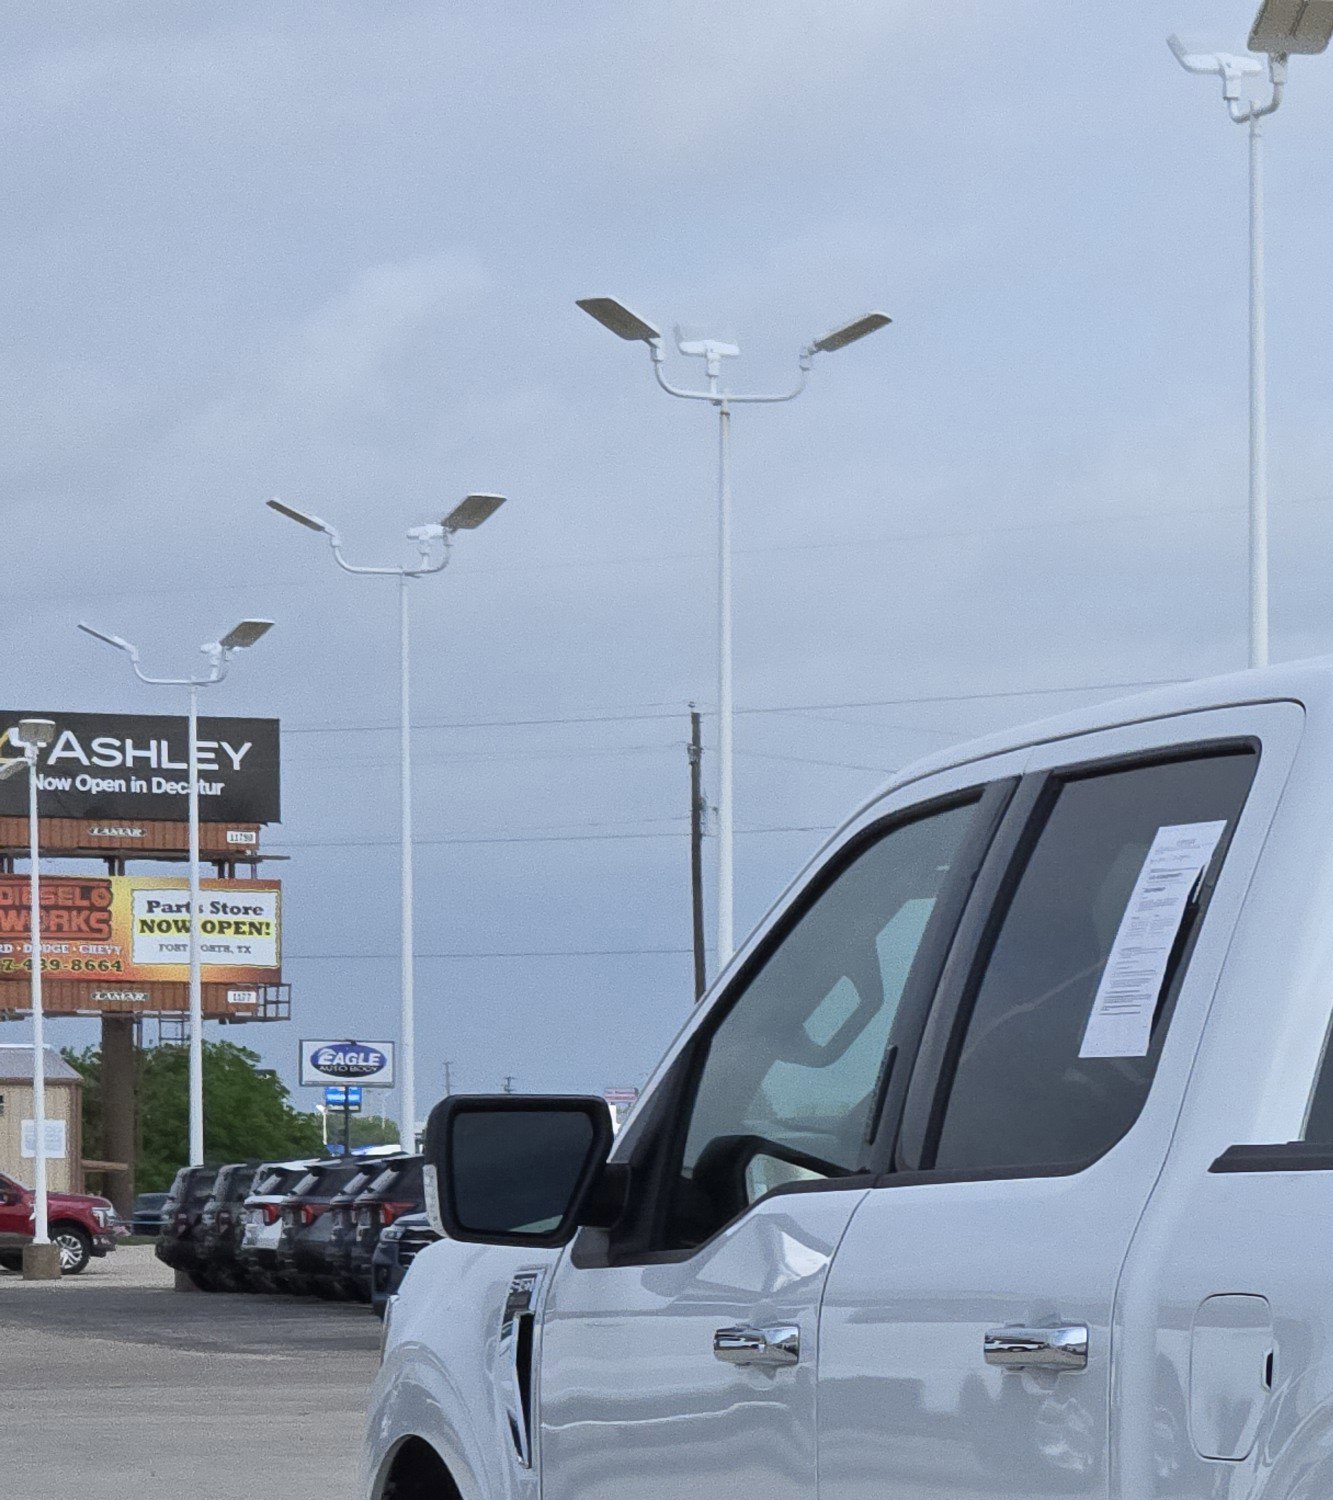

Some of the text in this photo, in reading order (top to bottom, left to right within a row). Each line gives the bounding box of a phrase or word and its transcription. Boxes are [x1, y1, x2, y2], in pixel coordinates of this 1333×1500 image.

[46, 729, 253, 771] ASHLEY
[75, 774, 127, 795] Open
[130, 776, 148, 794] in
[151, 777, 225, 795] Dectur
[210, 901, 264, 916] Store
[0, 908, 111, 937] WRKS
[138, 918, 271, 936] NOW OPEN!
[23, 944, 69, 954] DDGE
[1, 958, 123, 972] 7-439-8664
[317, 1048, 381, 1066] EAGLE
